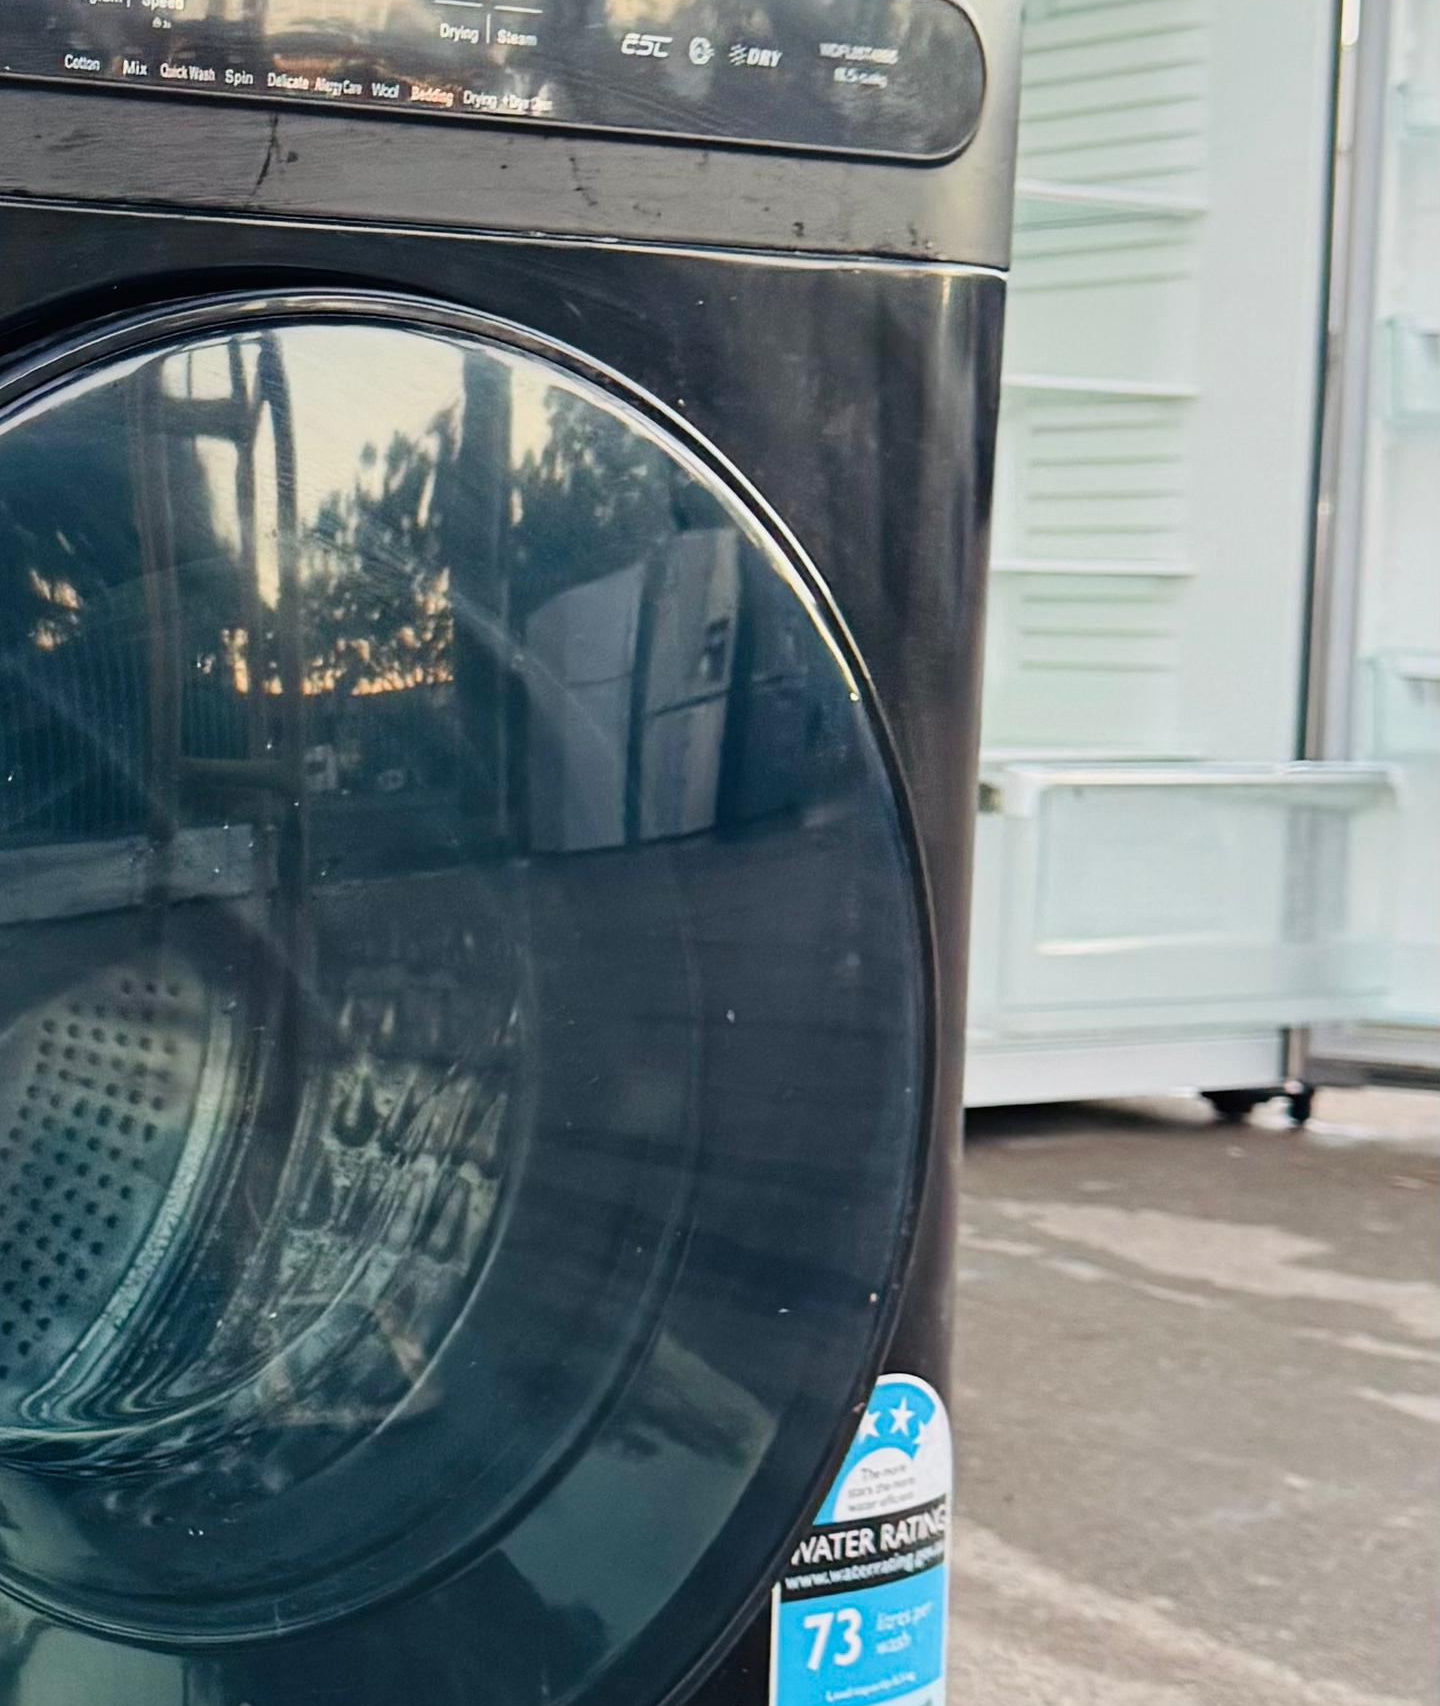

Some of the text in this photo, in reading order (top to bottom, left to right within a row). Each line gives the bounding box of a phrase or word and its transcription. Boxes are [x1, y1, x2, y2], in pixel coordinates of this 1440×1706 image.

[440, 23, 479, 44] Drying
[497, 29, 538, 47] Steam
[64, 54, 101, 71] Cotton
[746, 44, 783, 68] DRY
[123, 60, 148, 76] Mix
[160, 62, 216, 82] Quick Wash
[225, 69, 254, 87] Spin
[267, 72, 310, 91] Delicate
[372, 82, 400, 99] Wool
[410, 85, 455, 108] Bedding
[464, 89, 498, 109] Drying
[803, 1607, 862, 1671] 73
